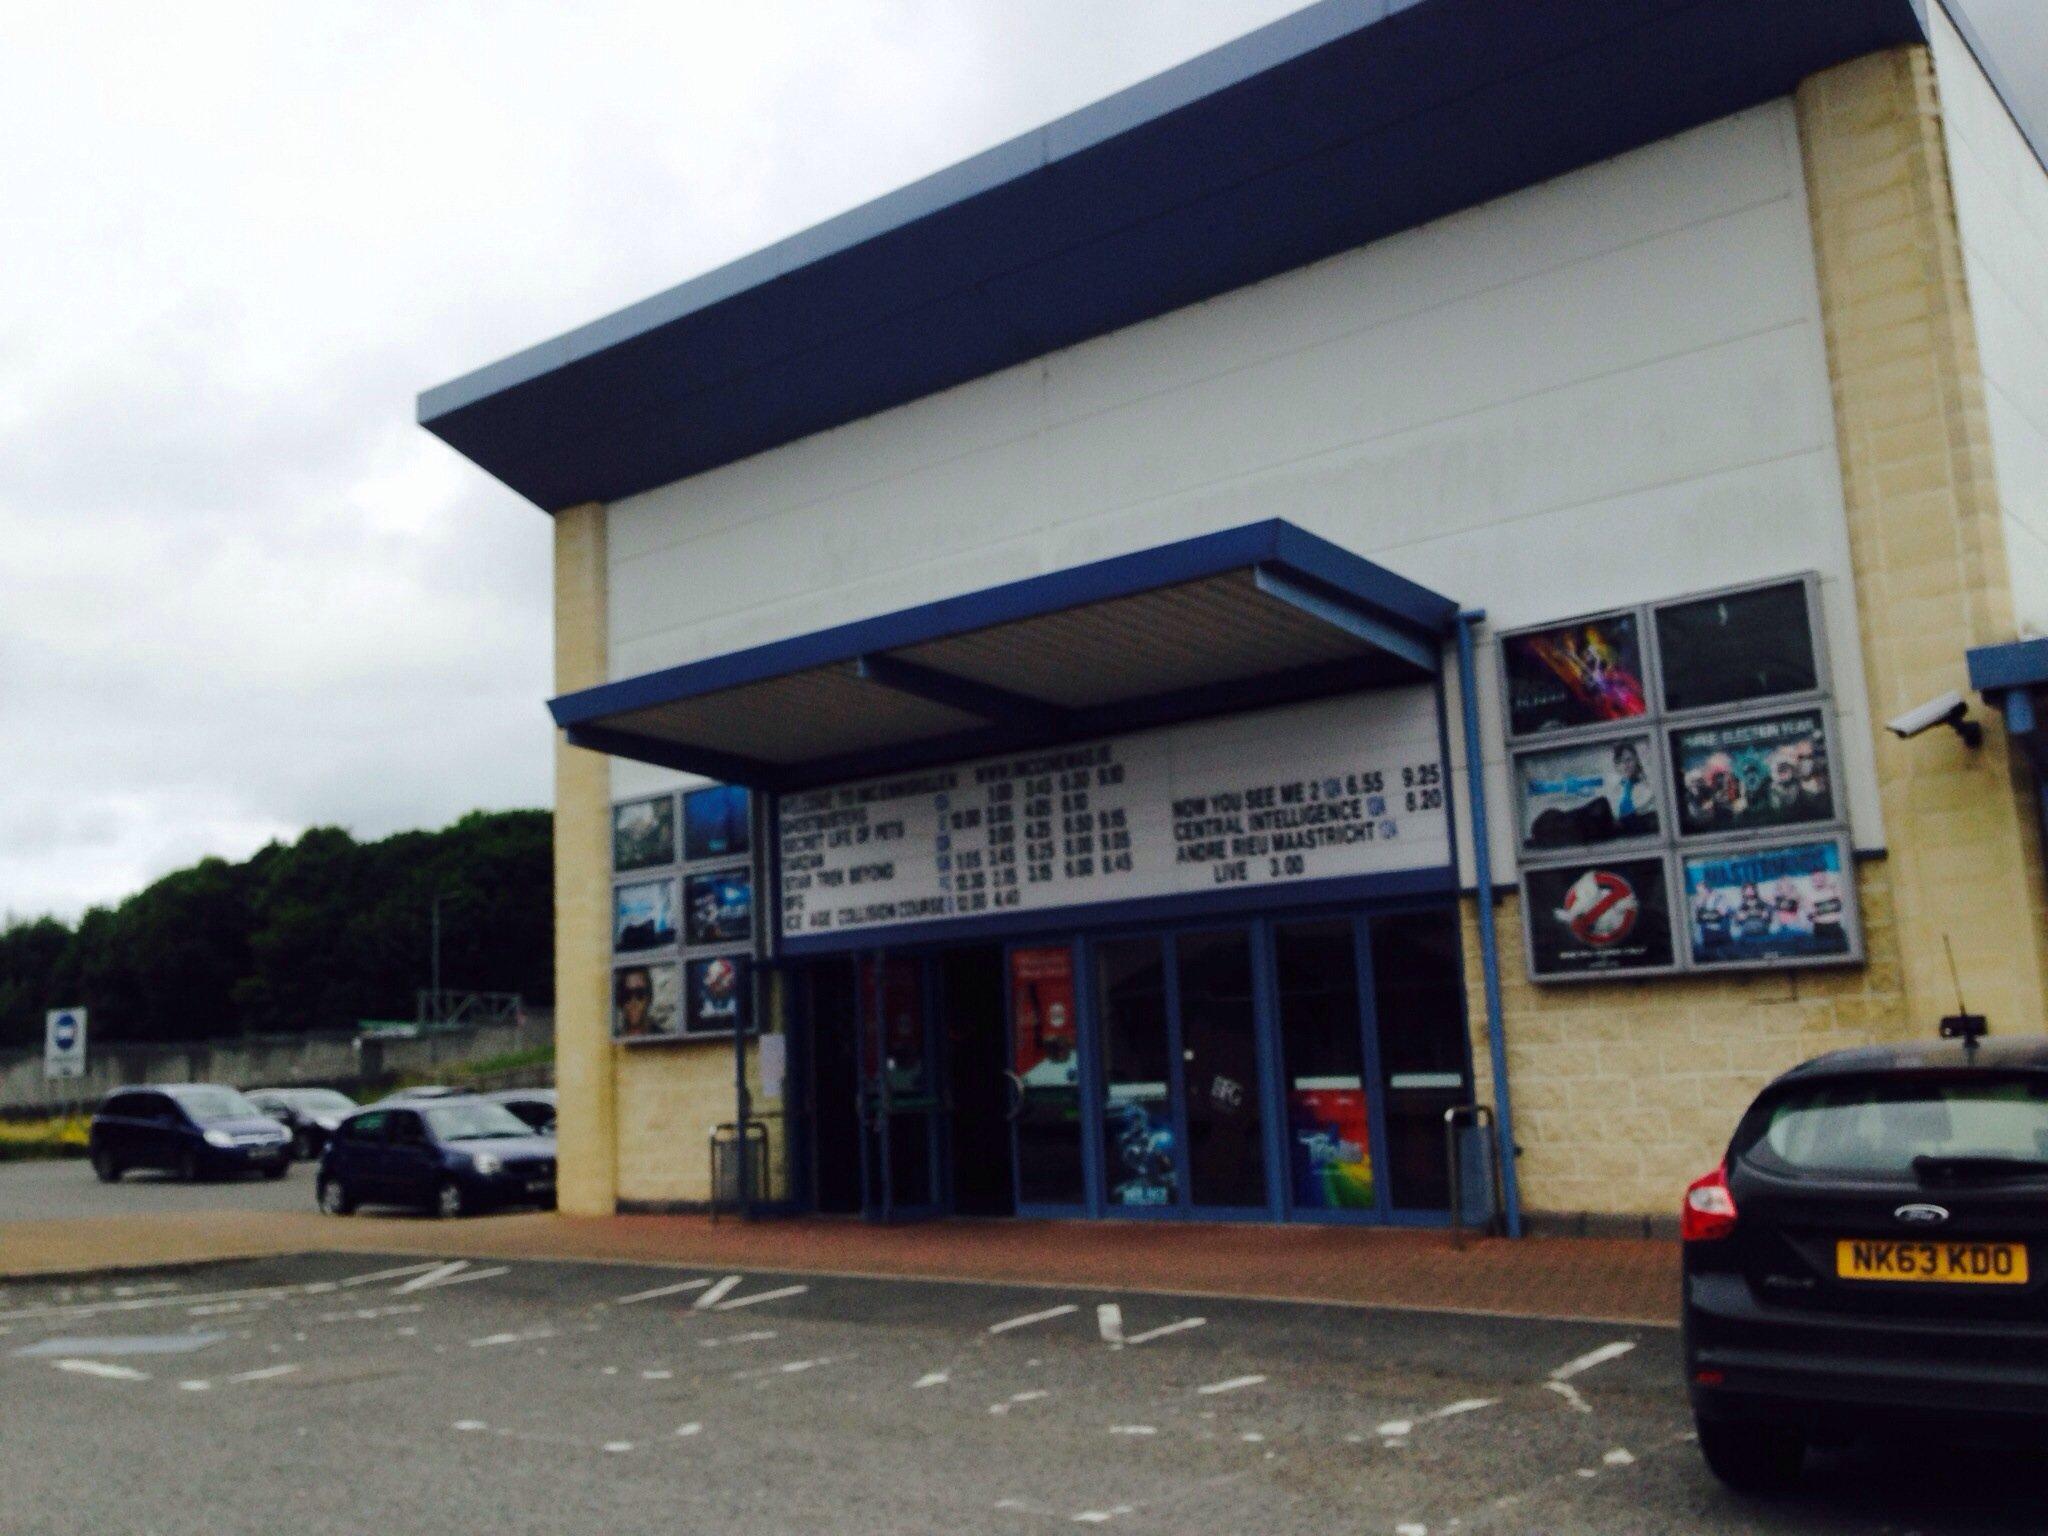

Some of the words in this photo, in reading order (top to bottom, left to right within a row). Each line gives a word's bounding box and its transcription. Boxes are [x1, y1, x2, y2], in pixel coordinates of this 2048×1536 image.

[1172, 797, 1207, 819] NOW
[1210, 792, 1243, 813] YOU
[1246, 786, 1274, 809] SEE
[1280, 781, 1304, 804] ME
[1310, 780, 1319, 801] 2
[1402, 763, 1440, 788] 9.25
[1174, 816, 1243, 842] CENTRAL
[1247, 798, 1362, 832] INTELLIGENCE
[1176, 839, 1225, 864] ANDRE
[1230, 835, 1269, 858] RIEU
[1270, 821, 1375, 852] MAASTRICHT
[849, 861, 895, 884] BEYOND
[1213, 861, 1247, 883] LIVE
[1269, 854, 1304, 878] 3.00
[838, 903, 895, 926] COLLISION
[898, 897, 944, 917] COURSE
[1853, 1239, 1938, 1275] NK63
[1947, 1244, 2013, 1276] KDO
